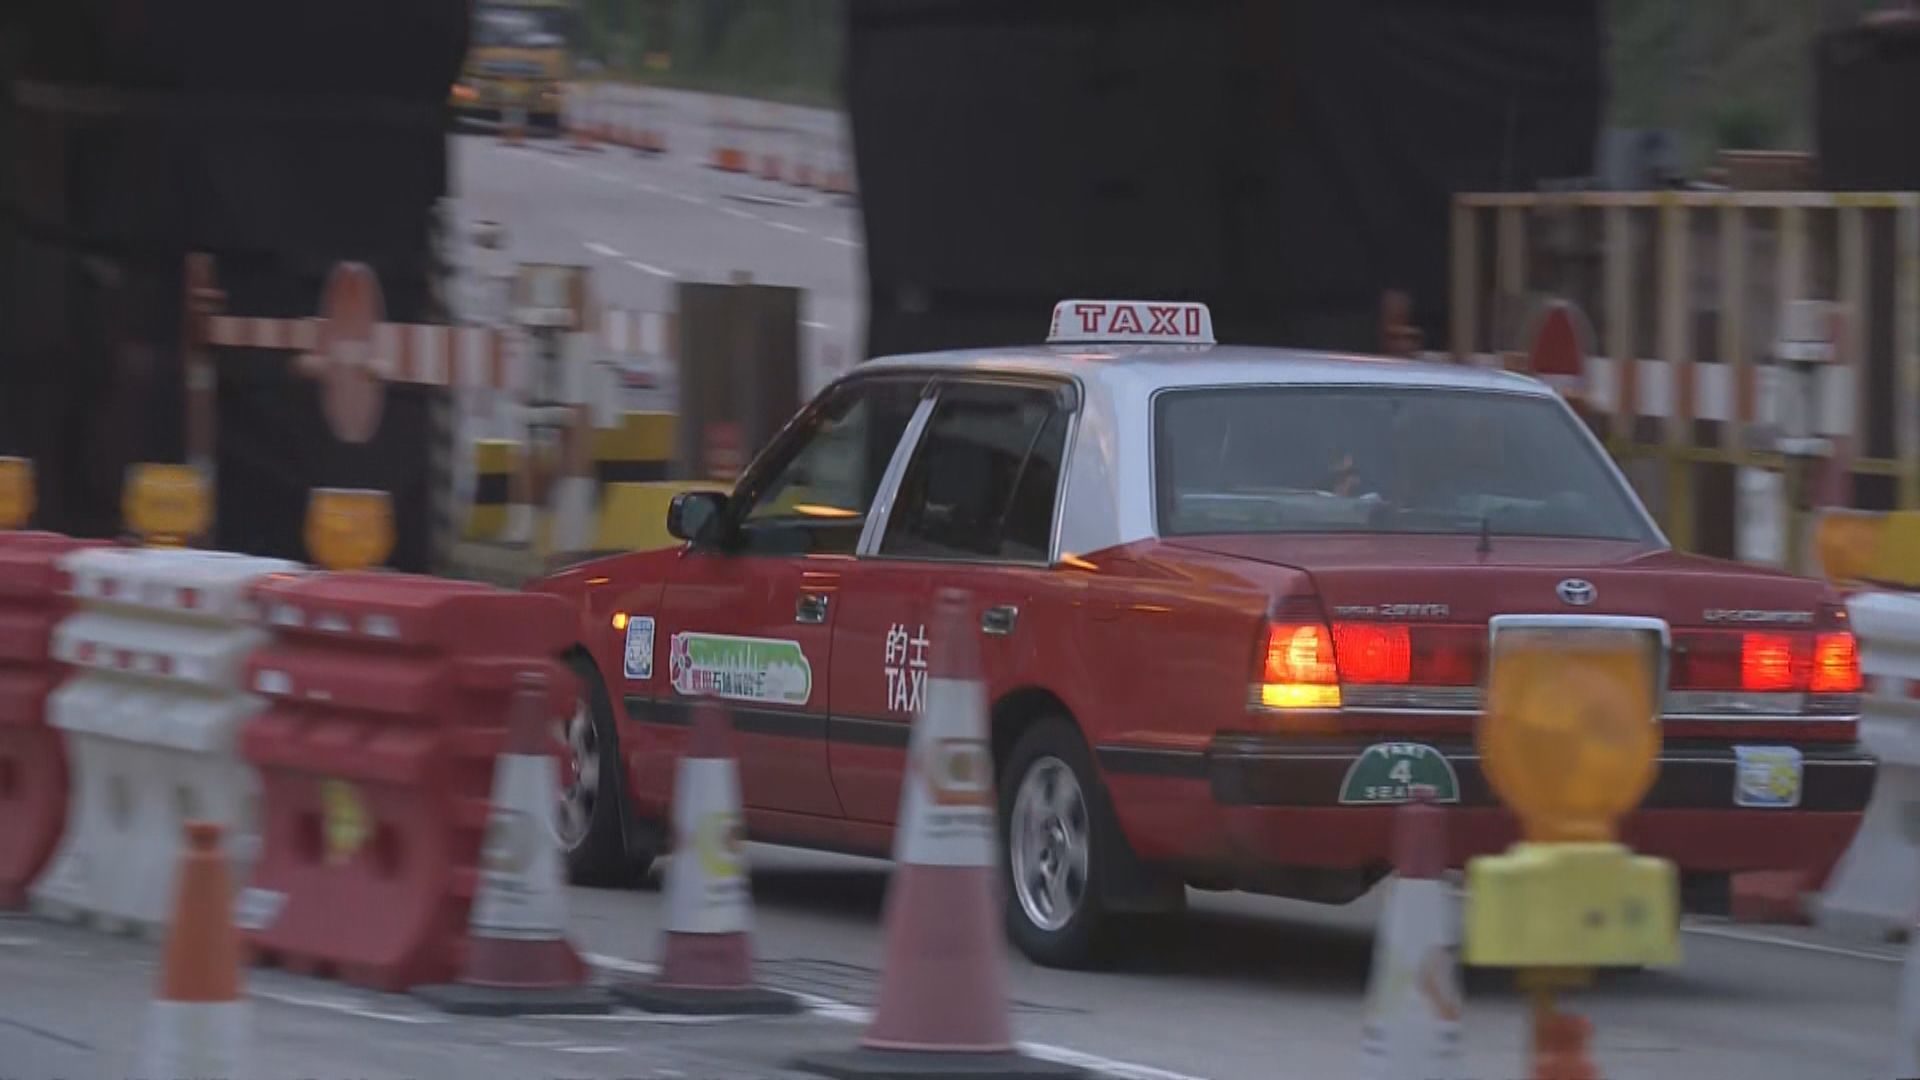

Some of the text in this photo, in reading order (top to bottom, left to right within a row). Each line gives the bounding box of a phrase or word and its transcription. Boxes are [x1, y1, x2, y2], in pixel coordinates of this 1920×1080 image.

[1075, 304, 1200, 336] TAXI
[884, 622, 930, 668] 的士
[884, 667, 929, 712] TAXI
[1388, 760, 1412, 783] 4
